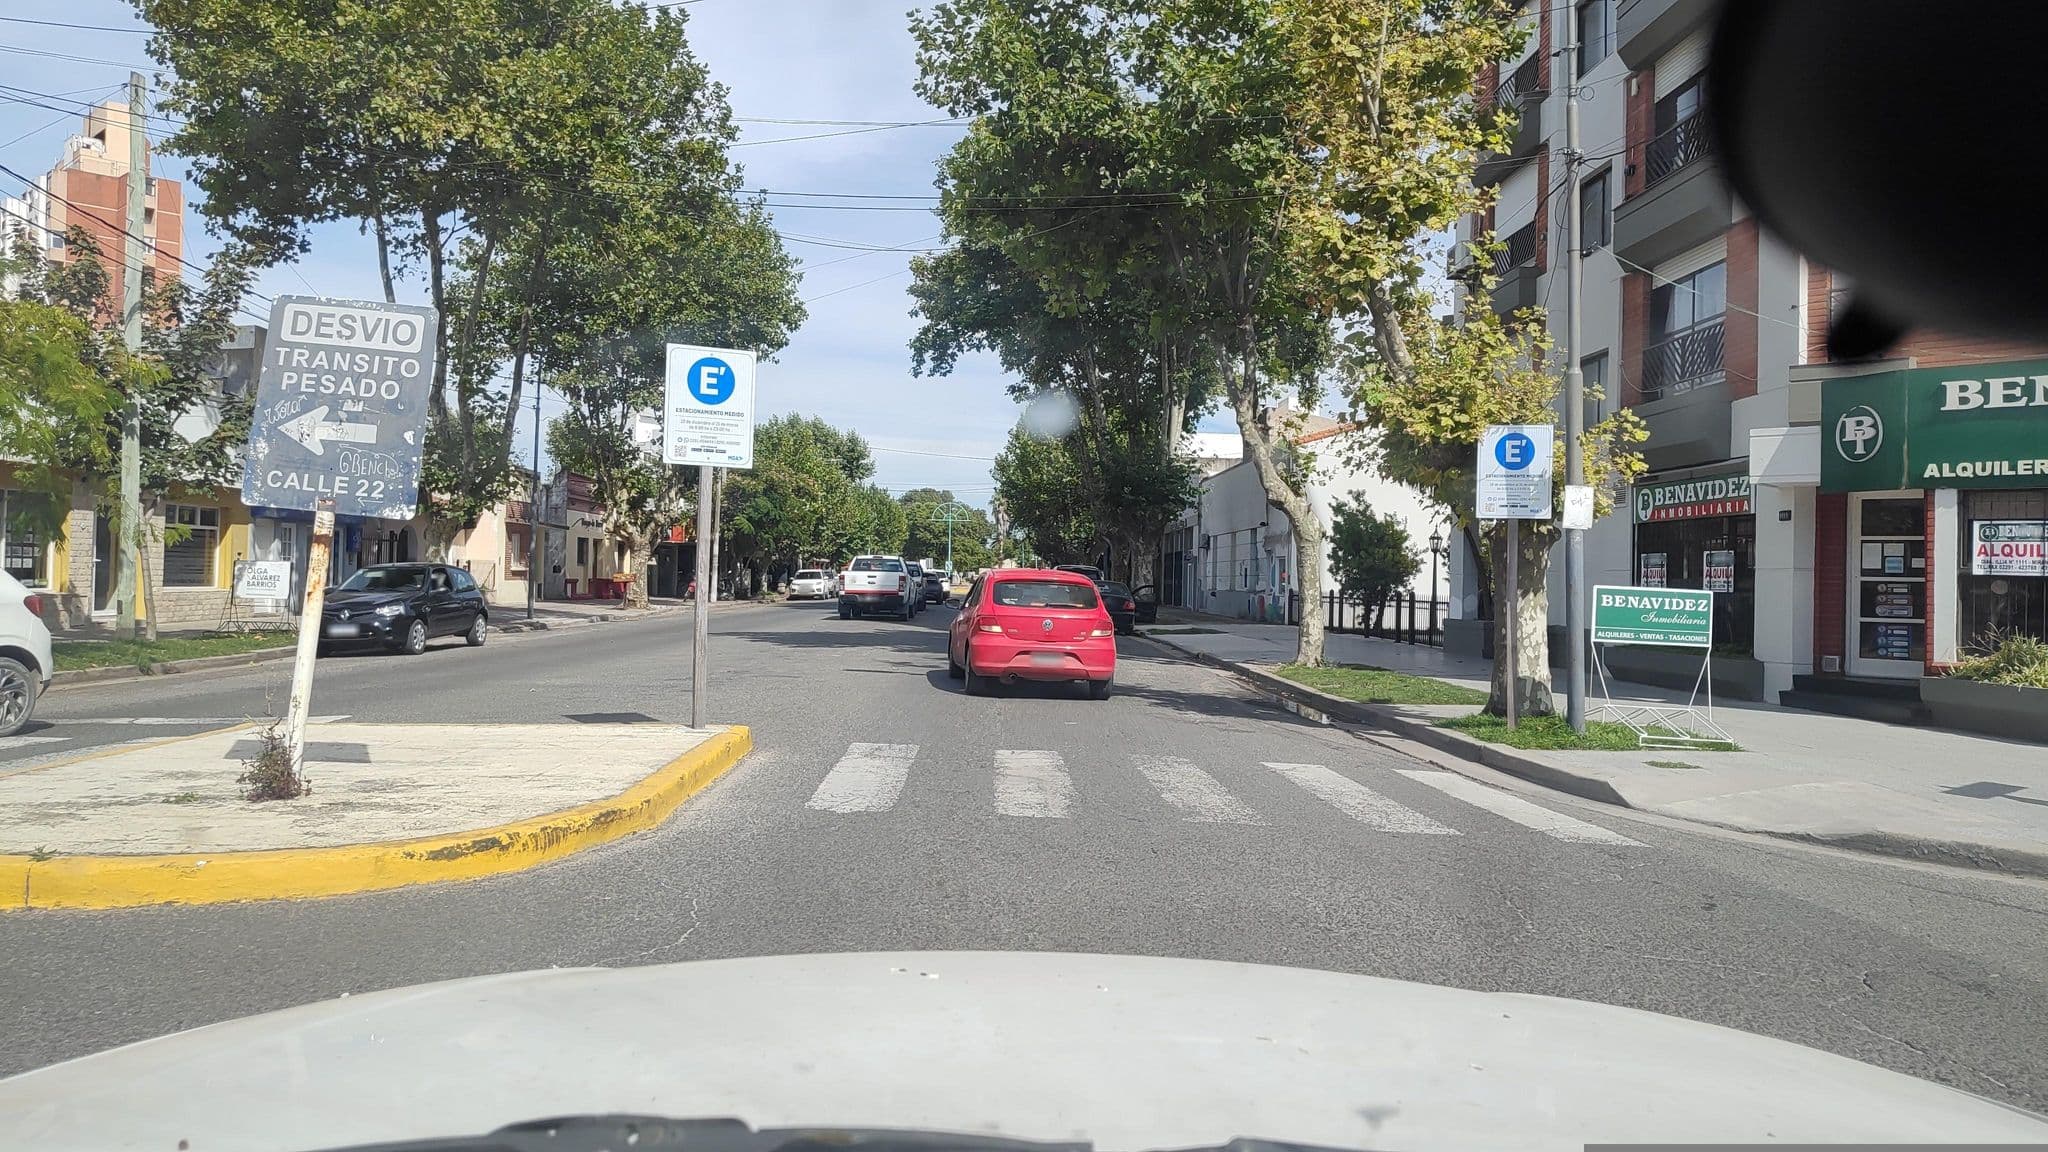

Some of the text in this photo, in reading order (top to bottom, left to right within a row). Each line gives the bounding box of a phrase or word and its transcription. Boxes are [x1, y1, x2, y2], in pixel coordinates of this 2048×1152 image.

[290, 310, 417, 346] DESVIO
[276, 347, 421, 378] TRANSITO
[281, 372, 400, 399] PESADO
[676, 408, 723, 416] ESTACIONAMIENTO
[267, 470, 385, 498] CALLE 22
[1654, 476, 1750, 505] BENAVIDEZ
[1654, 500, 1749, 520] INMOBILIARIA
[1601, 594, 1708, 612] BENAVIDEZ
[1641, 611, 1707, 625] Inmobiliaria
[1597, 631, 1635, 639] ALQUILERES
[1669, 634, 1707, 642] TASACIONES
